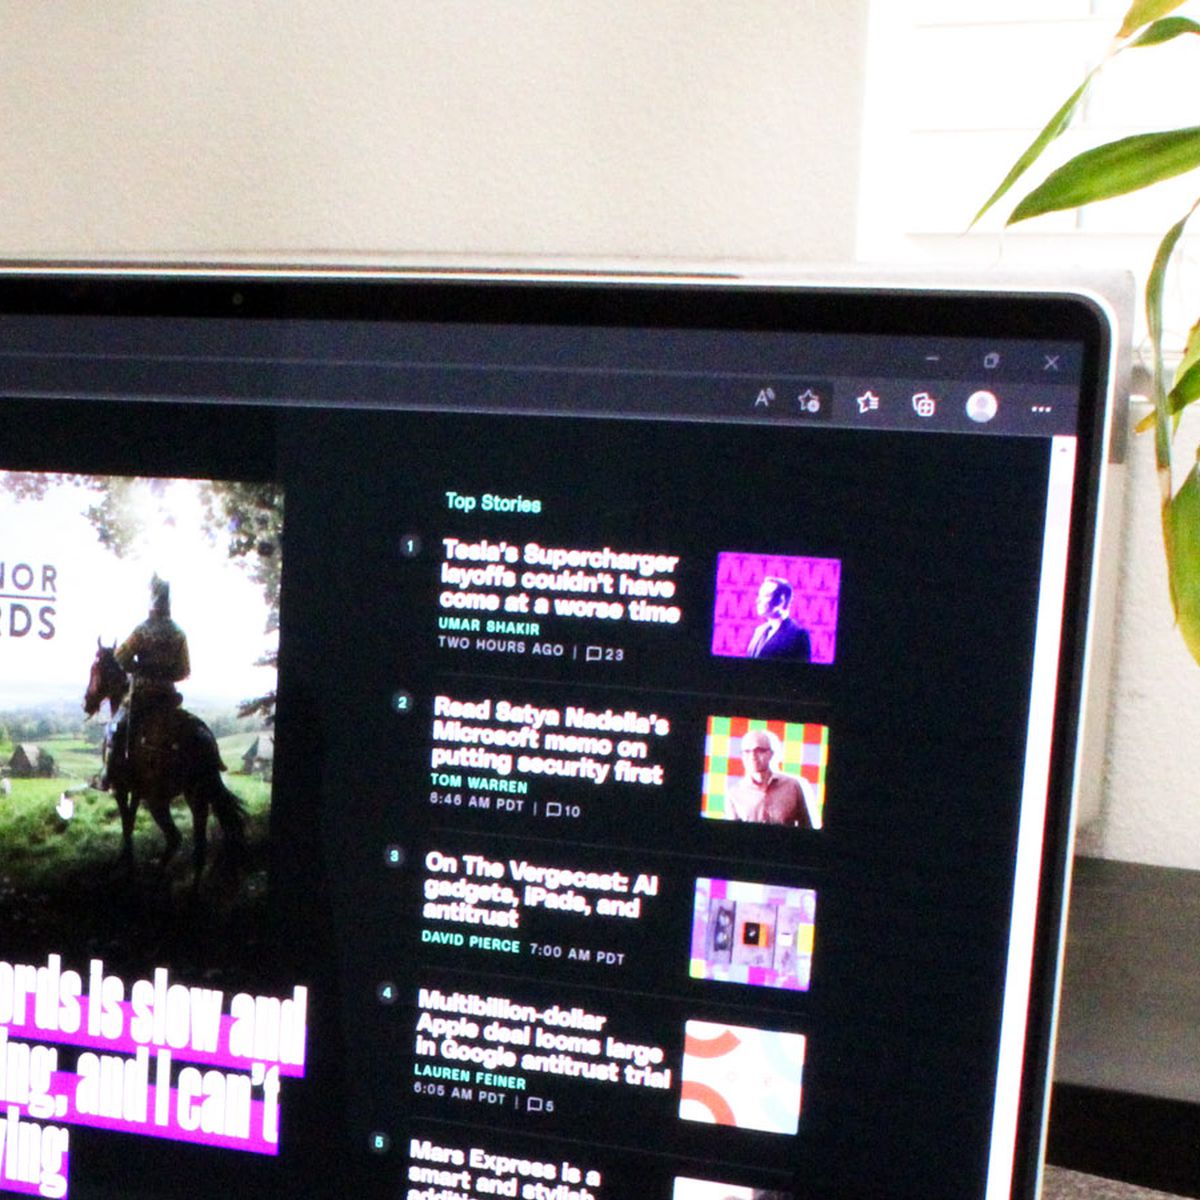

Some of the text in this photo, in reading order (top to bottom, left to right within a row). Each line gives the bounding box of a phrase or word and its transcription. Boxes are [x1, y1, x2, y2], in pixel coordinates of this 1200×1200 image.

[446, 492, 541, 514] Top Stories
[444, 539, 679, 576] Tesla's Supercharger
[441, 563, 675, 598] layoffs couldn't have
[439, 593, 681, 624] come at a worse time
[438, 617, 540, 636] UMAR SHAKIR
[438, 636, 624, 660] TWO HOURS AGO 23
[435, 696, 669, 735] Read Satya Nadella's
[433, 721, 647, 757] Microsoft memo on
[431, 749, 663, 785] putting security first
[431, 774, 527, 794] TOM WARREN
[429, 792, 580, 818] 8:46 AM PDT 10
[426, 851, 658, 895] On The Vergecast: AI
[423, 902, 519, 928] antitrust
[424, 880, 640, 919] gadgets, iPads, and
[421, 931, 625, 965] DAVID PIERCE 7:00 AM PDT
[88, 959, 123, 1040] is
[131, 968, 223, 1053] slow
[229, 985, 307, 1065] and
[418, 989, 607, 1031] Multibillion-dollar
[416, 1015, 663, 1067] Apple deal looms large
[414, 1064, 525, 1090] LAUREN FEINER
[415, 1040, 671, 1089] in Google antitrust trial
[75, 1046, 149, 1125] and
[155, 1050, 171, 1126] I
[177, 1063, 280, 1143] can't
[414, 1082, 553, 1112] 6:05 AM PDT 5
[410, 1139, 600, 1186] Mars Express is a
[409, 1169, 470, 1192] smart
[476, 1178, 517, 1198] and
